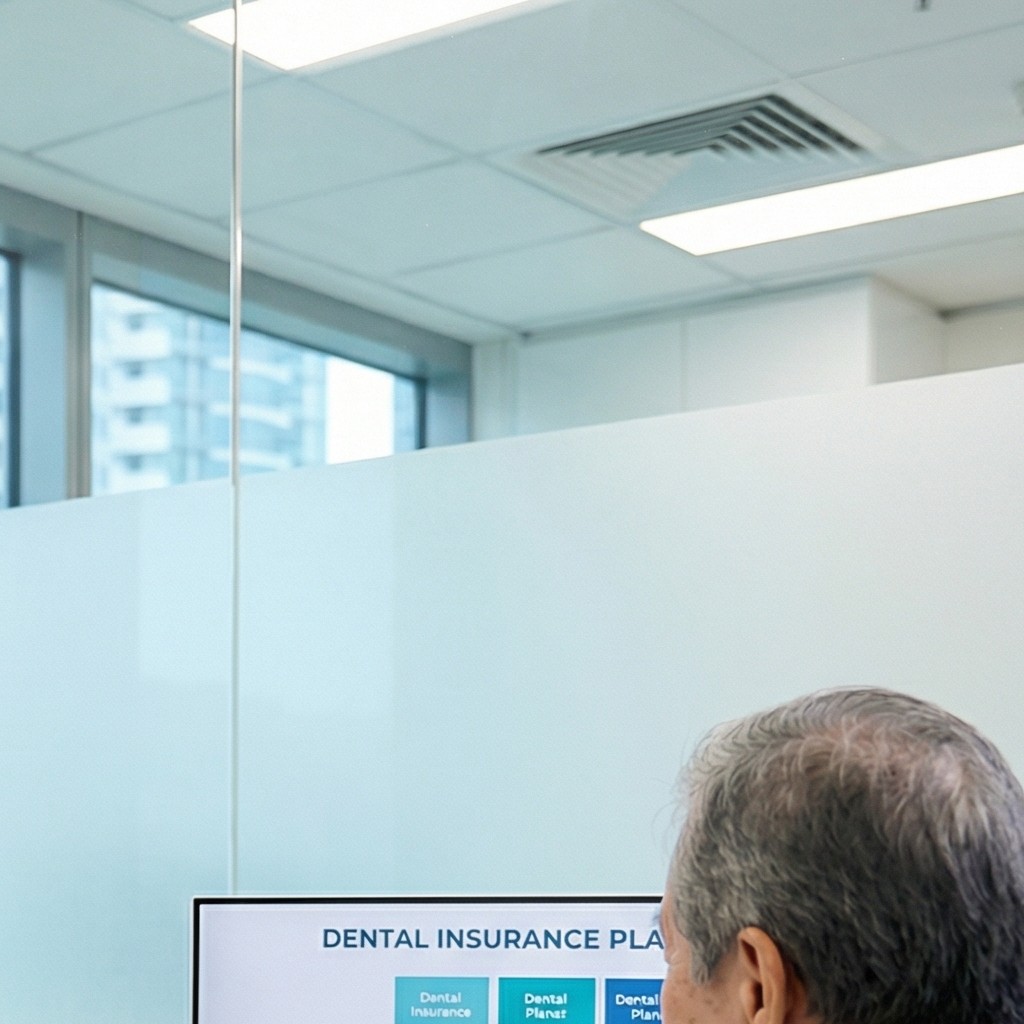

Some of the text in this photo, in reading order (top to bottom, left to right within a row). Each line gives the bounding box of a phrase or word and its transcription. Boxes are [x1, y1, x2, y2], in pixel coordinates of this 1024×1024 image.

[323, 928, 429, 949] DENTAL
[437, 928, 600, 950] INSURANCE
[524, 993, 567, 1005] Dental
[615, 994, 659, 1006] Dental
